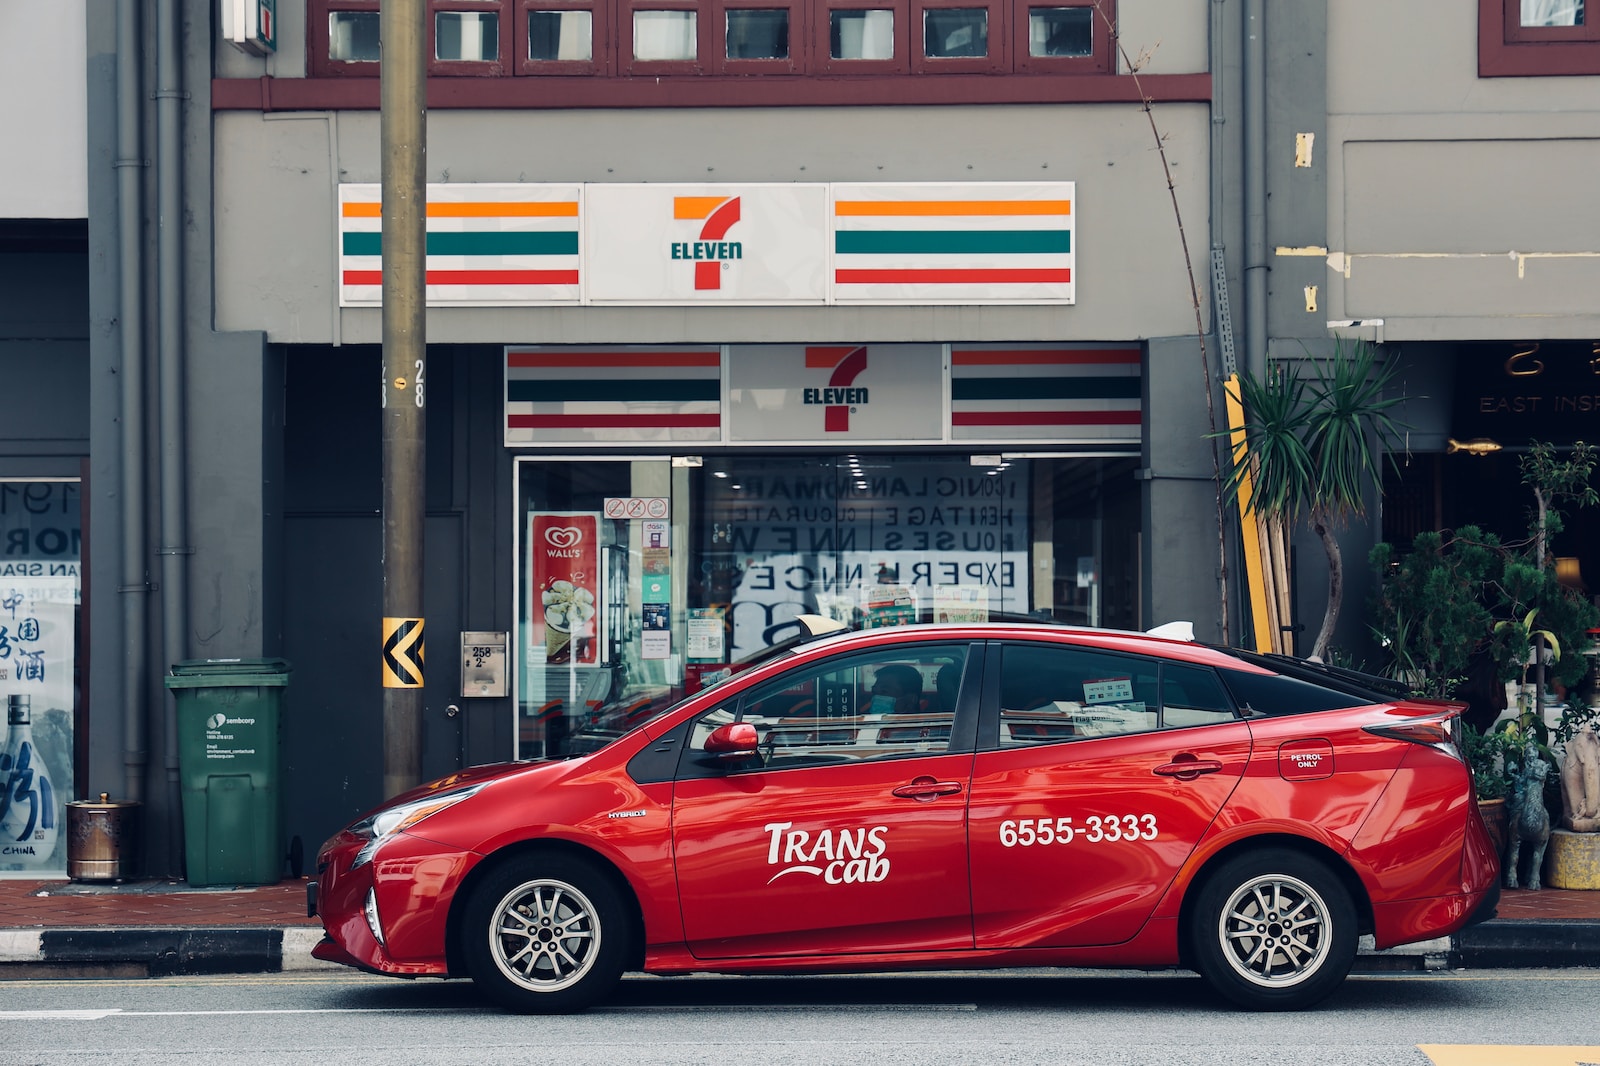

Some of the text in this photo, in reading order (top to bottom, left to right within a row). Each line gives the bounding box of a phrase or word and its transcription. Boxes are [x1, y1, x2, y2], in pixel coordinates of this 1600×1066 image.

[415, 359, 424, 408] 28
[1479, 397, 1542, 413] EAST
[547, 549, 580, 558] WALL'S
[472, 647, 491, 658] 258
[226, 717, 255, 725] sembcorp
[1291, 753, 1323, 762] PETROL
[1297, 760, 1319, 768] ONLY
[999, 813, 1159, 848] 6555-3333
[2, 846, 36, 856] CHINA
[823, 850, 891, 885] cab
